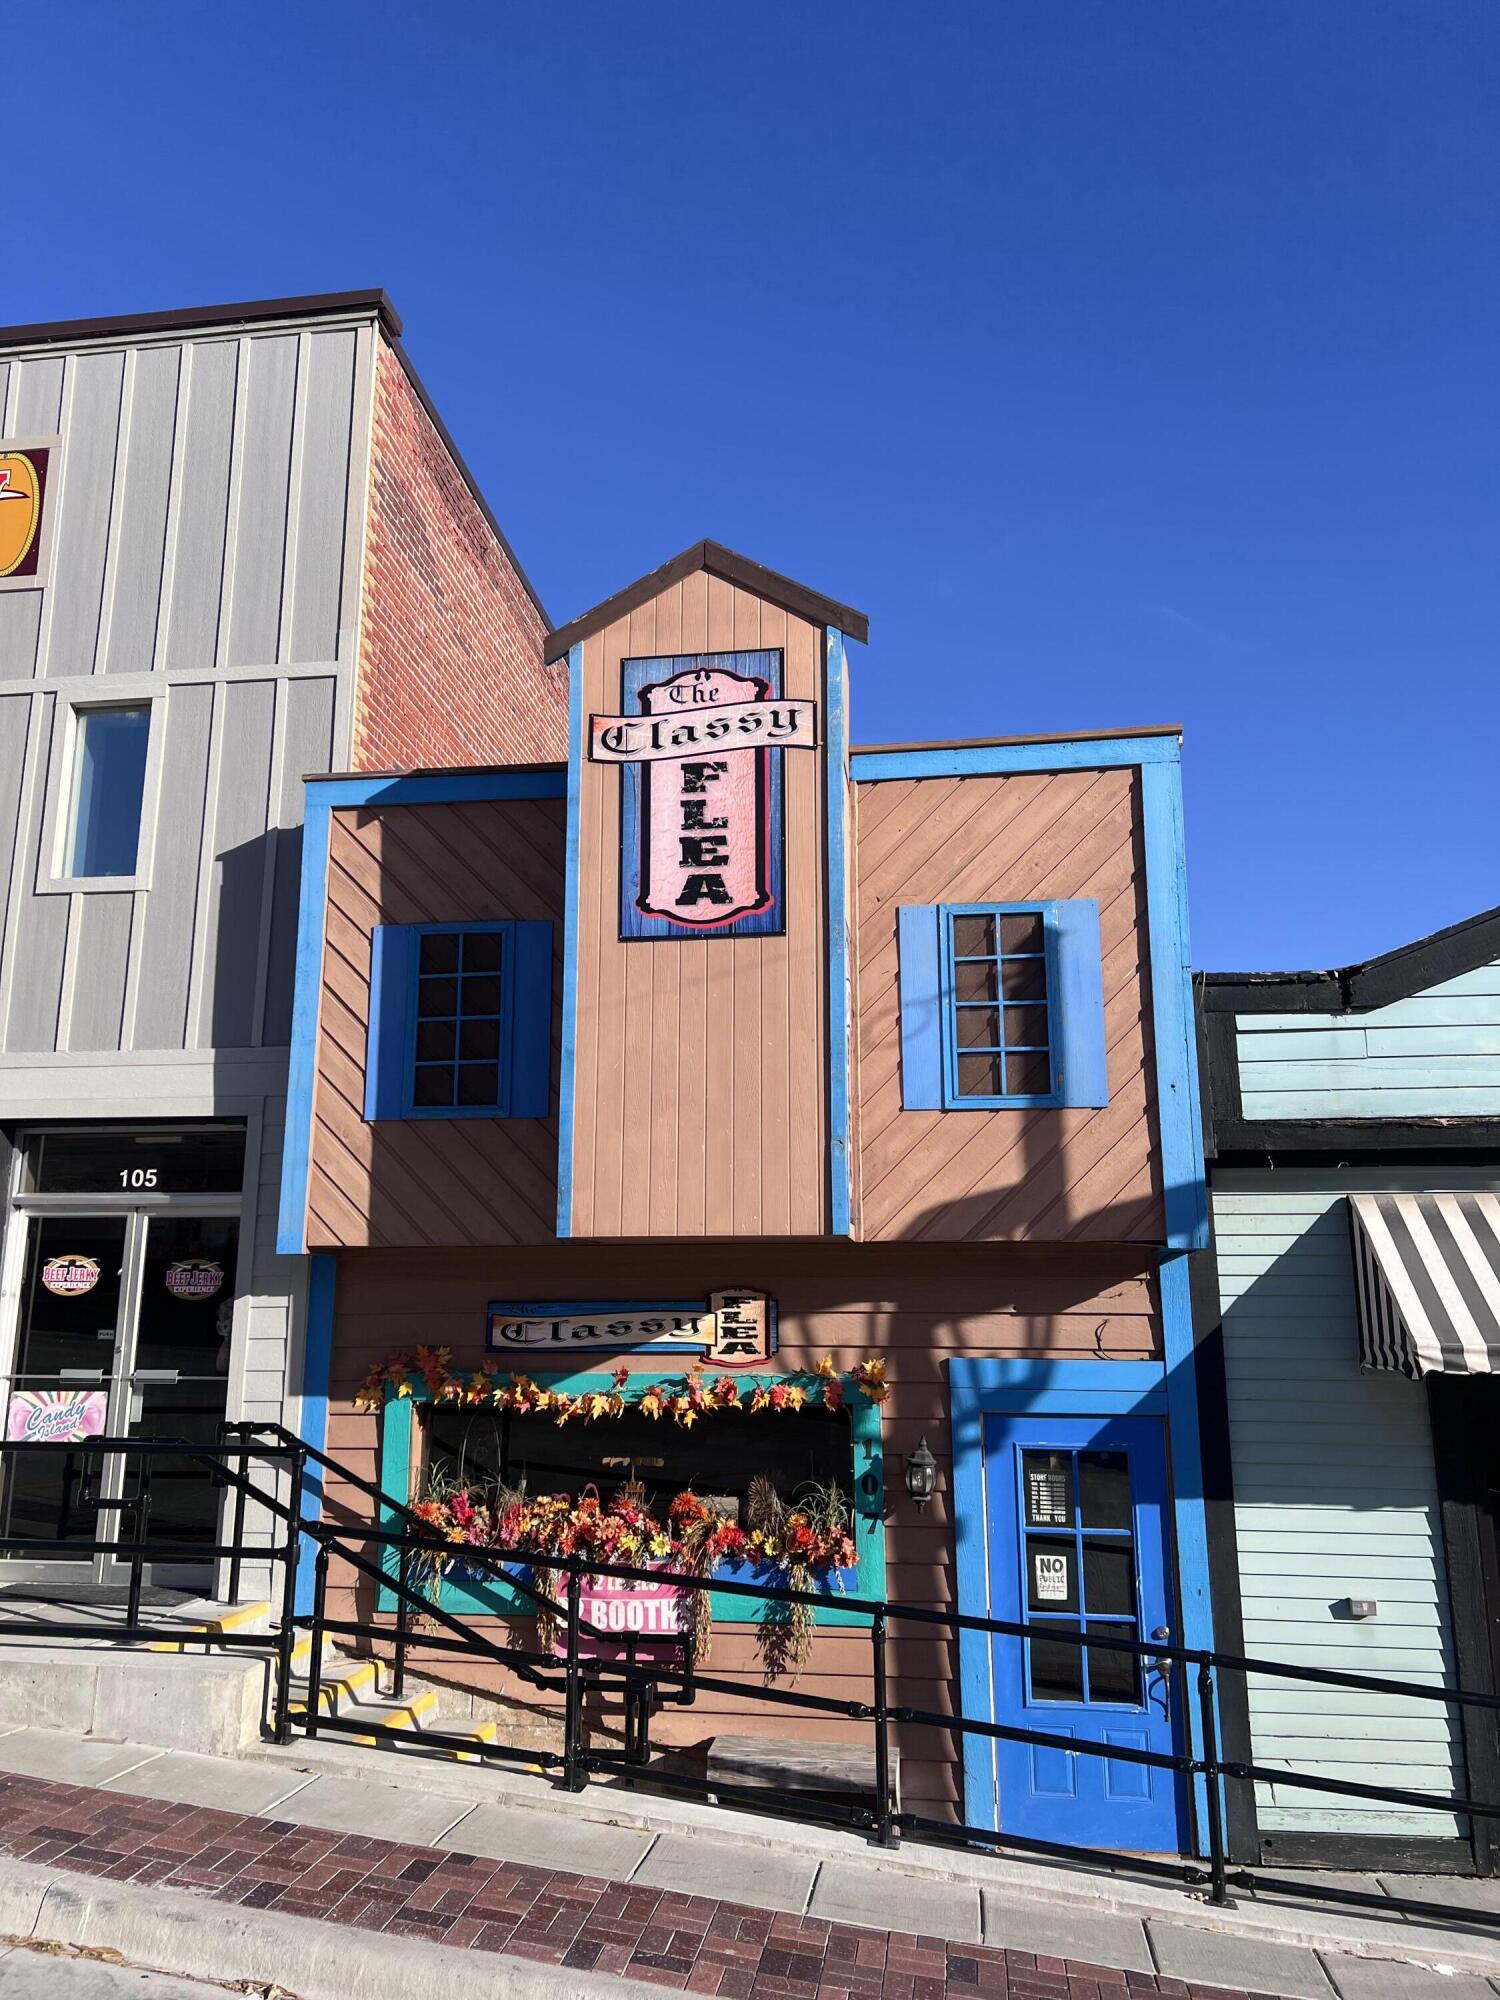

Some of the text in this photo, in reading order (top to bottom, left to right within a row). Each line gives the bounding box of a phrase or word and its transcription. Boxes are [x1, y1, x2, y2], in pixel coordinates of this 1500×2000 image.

[666, 683, 720, 705] The
[600, 708, 803, 756] Classy
[675, 761, 733, 906] FLEA
[119, 1169, 158, 1188] 105
[42, 1265, 101, 1282] BEEF JERKY
[166, 1270, 225, 1287] BEEF JERKY
[500, 1316, 702, 1345] Classy
[717, 1295, 762, 1355] FLEA
[27, 1401, 86, 1431] Candy
[37, 1418, 78, 1438] Island
[1030, 1473, 1047, 1481] STORE
[1032, 1514, 1067, 1523] THANK YOU
[1039, 1557, 1064, 1574] NO
[1039, 1574, 1065, 1584] PUBLIC
